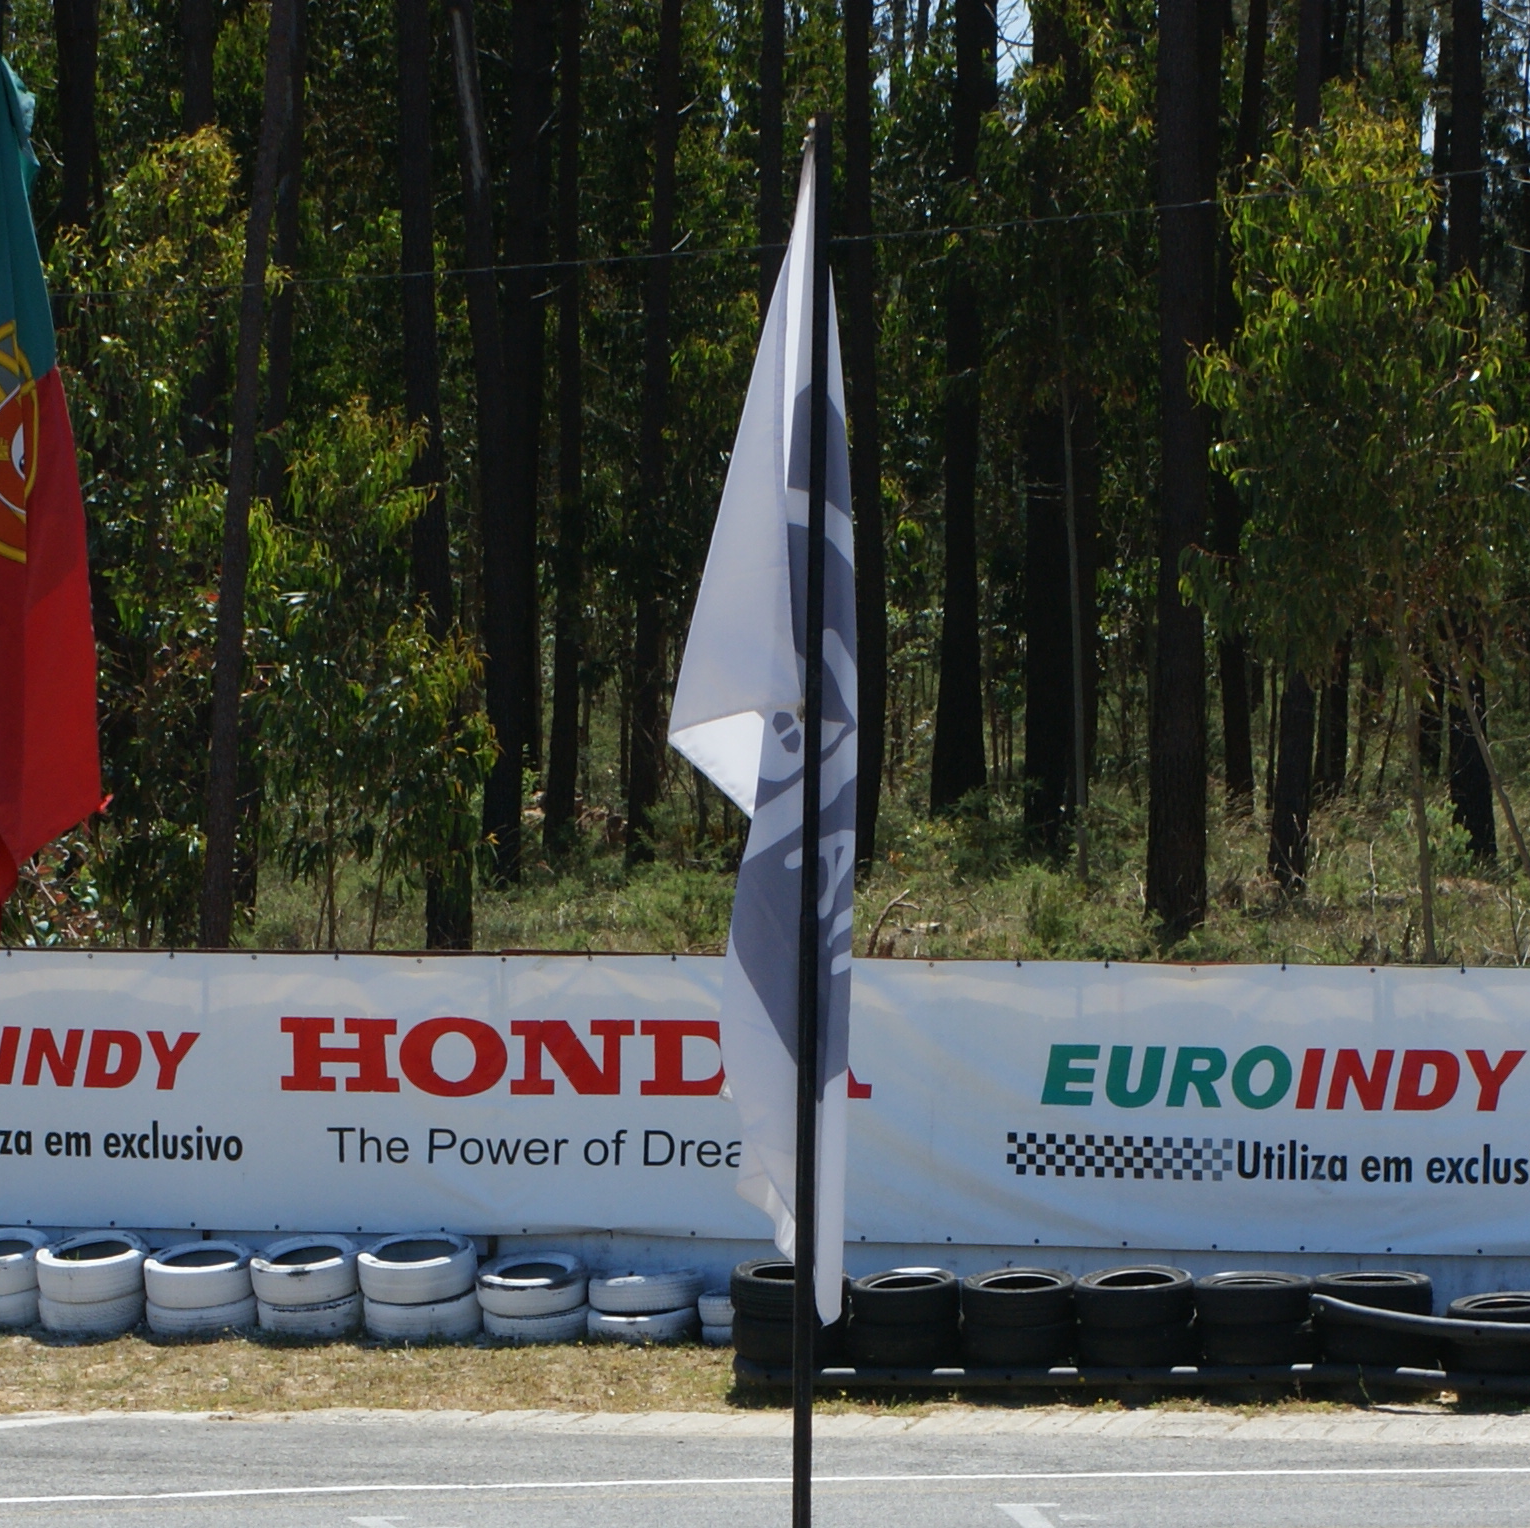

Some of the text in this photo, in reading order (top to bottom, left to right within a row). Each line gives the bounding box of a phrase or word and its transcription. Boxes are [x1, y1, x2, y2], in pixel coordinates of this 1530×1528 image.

[280, 1016, 872, 1099] HOND
[1040, 1043, 1527, 1112] EUROINDY
[44, 1131, 92, 1158] em
[103, 1120, 244, 1162] exclusivo
[326, 1126, 743, 1169] The Power of Drea
[1237, 1139, 1348, 1182] Utiliza
[1360, 1155, 1413, 1183] em
